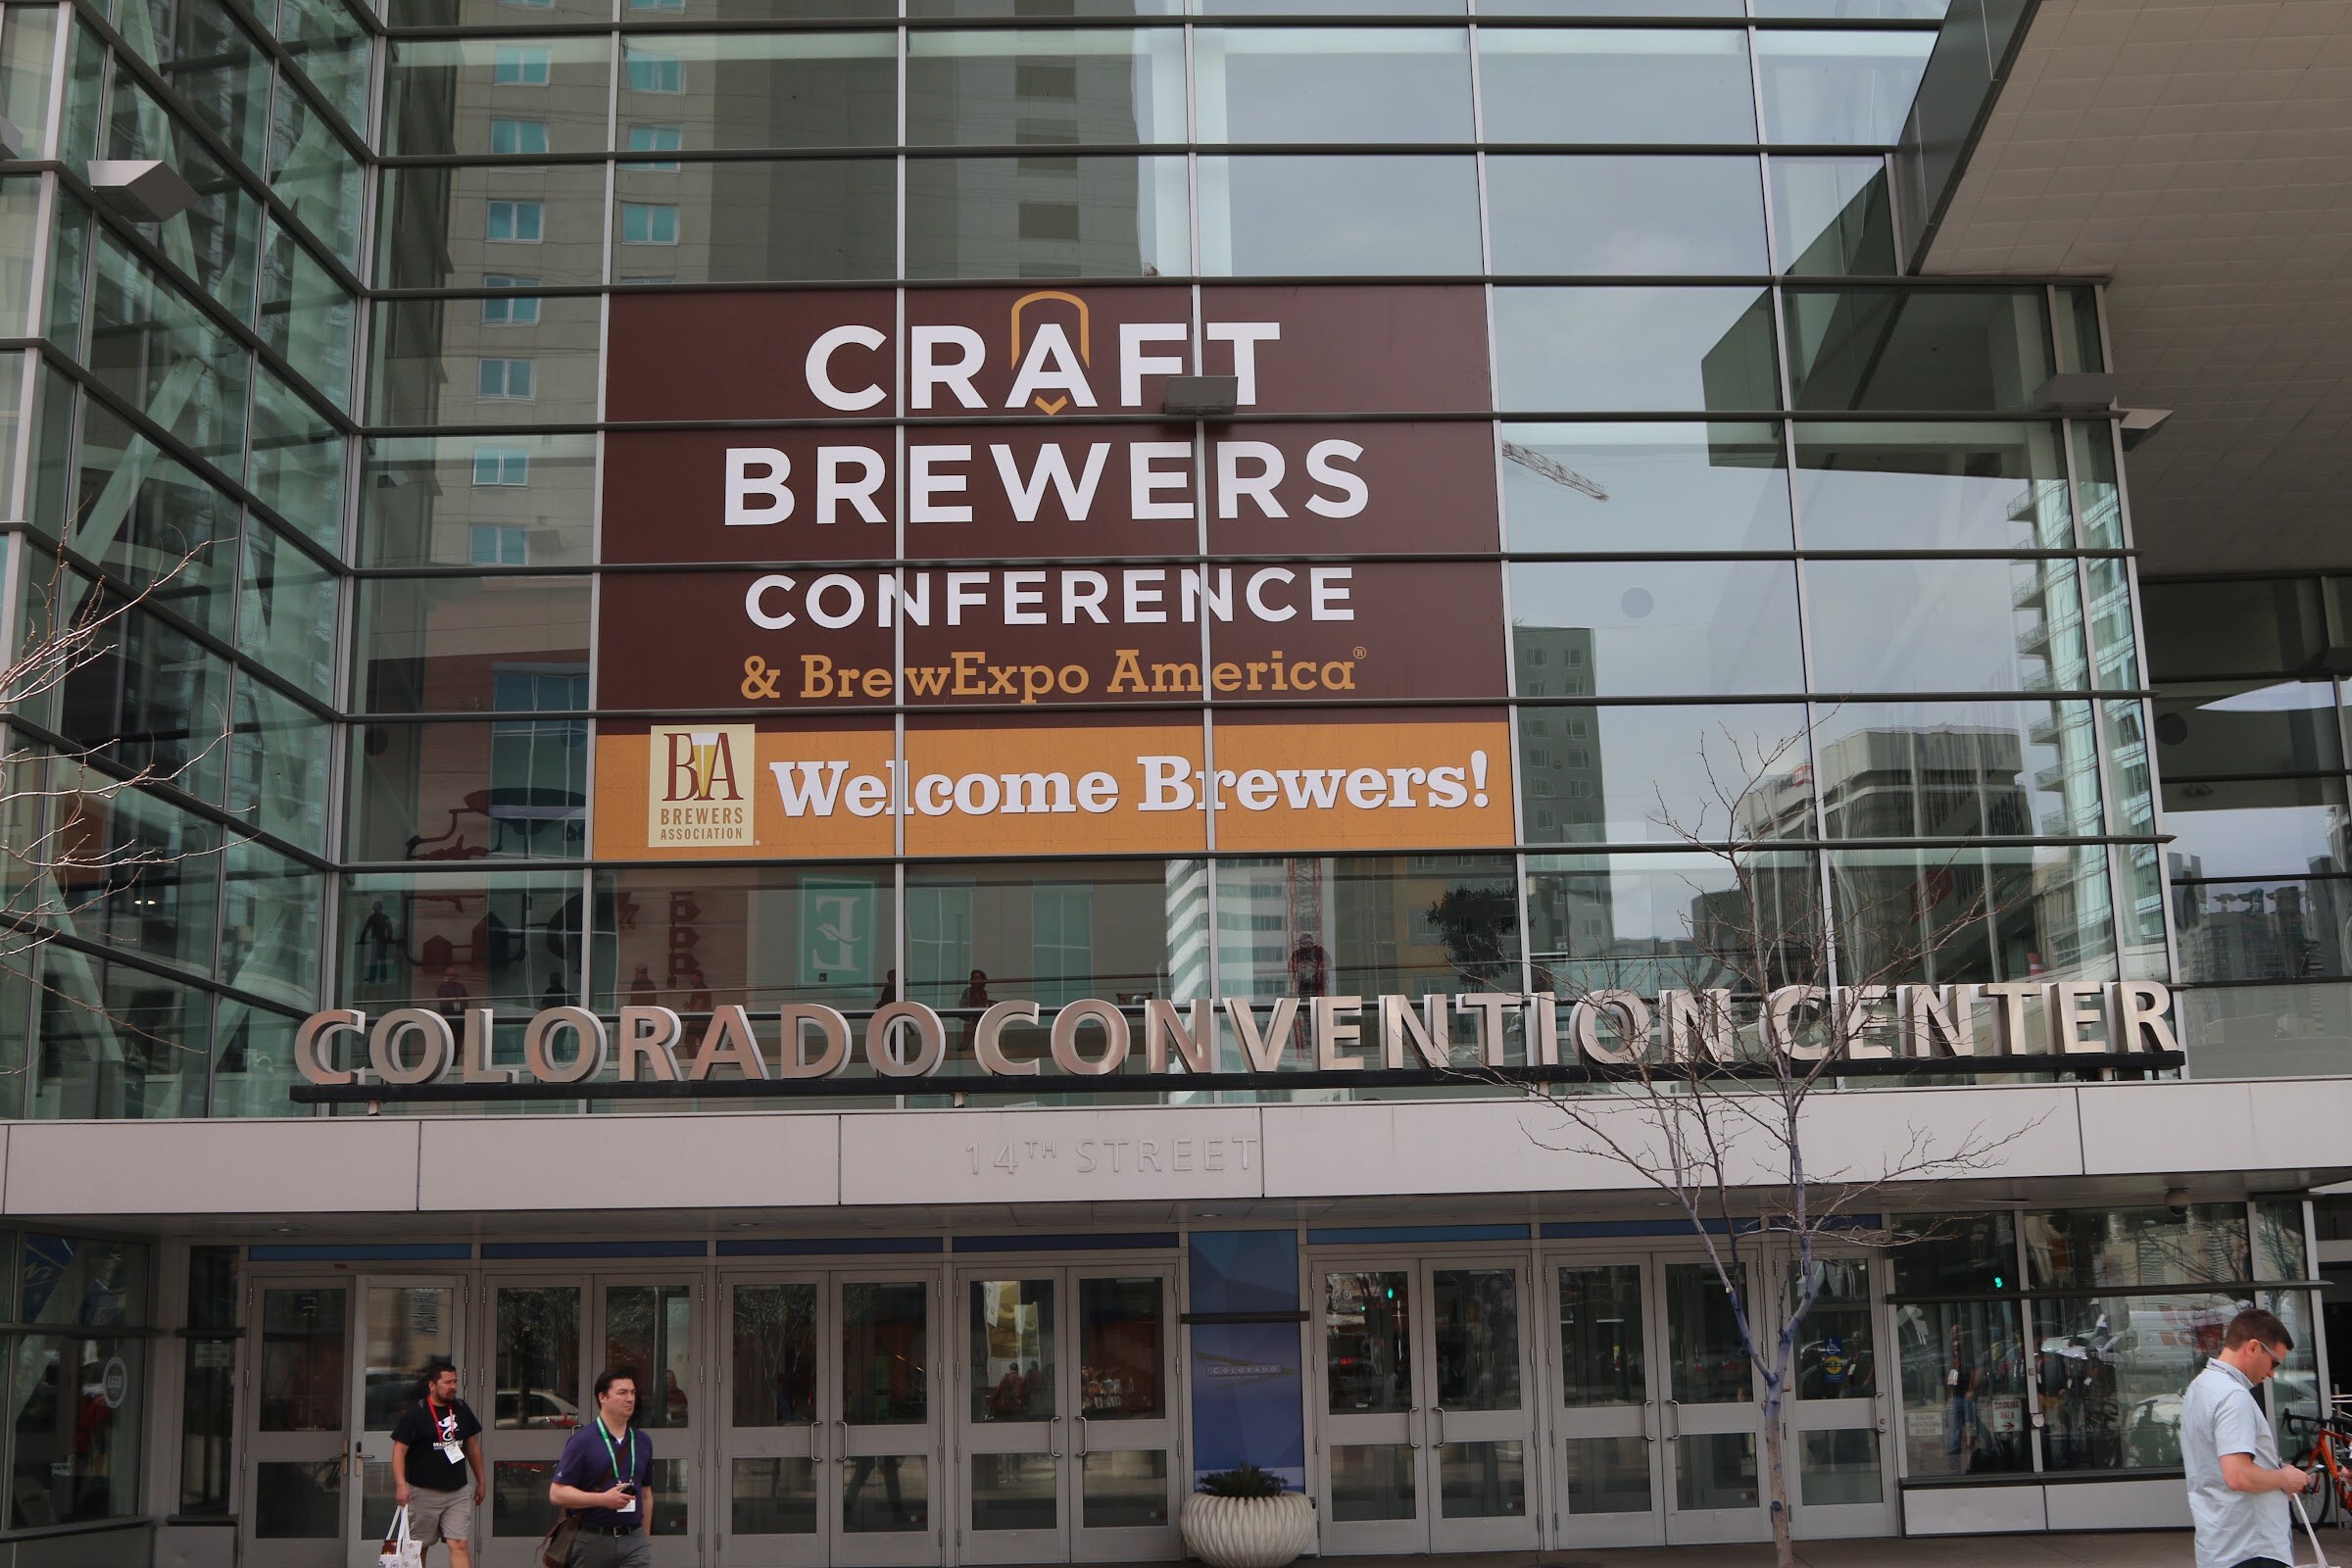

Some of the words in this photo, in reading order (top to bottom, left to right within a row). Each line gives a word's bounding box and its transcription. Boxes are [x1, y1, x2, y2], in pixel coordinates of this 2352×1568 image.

[805, 321, 1280, 412] CRAFT
[724, 439, 1369, 526] BREWERS
[745, 566, 1354, 630] CONFERENCE
[741, 655, 781, 700] &
[800, 651, 1090, 704] BrewExpo
[769, 760, 1119, 817] Welcome
[1137, 750, 1490, 811] Brewers!
[661, 808, 743, 825] BREWERS
[661, 827, 742, 841] ASSOCIATION
[294, 1001, 946, 1085] COLORADO
[974, 986, 1735, 1077] CONVENTION
[1762, 980, 2180, 1061] CENTER
[1076, 1137, 1258, 1174] STREET
